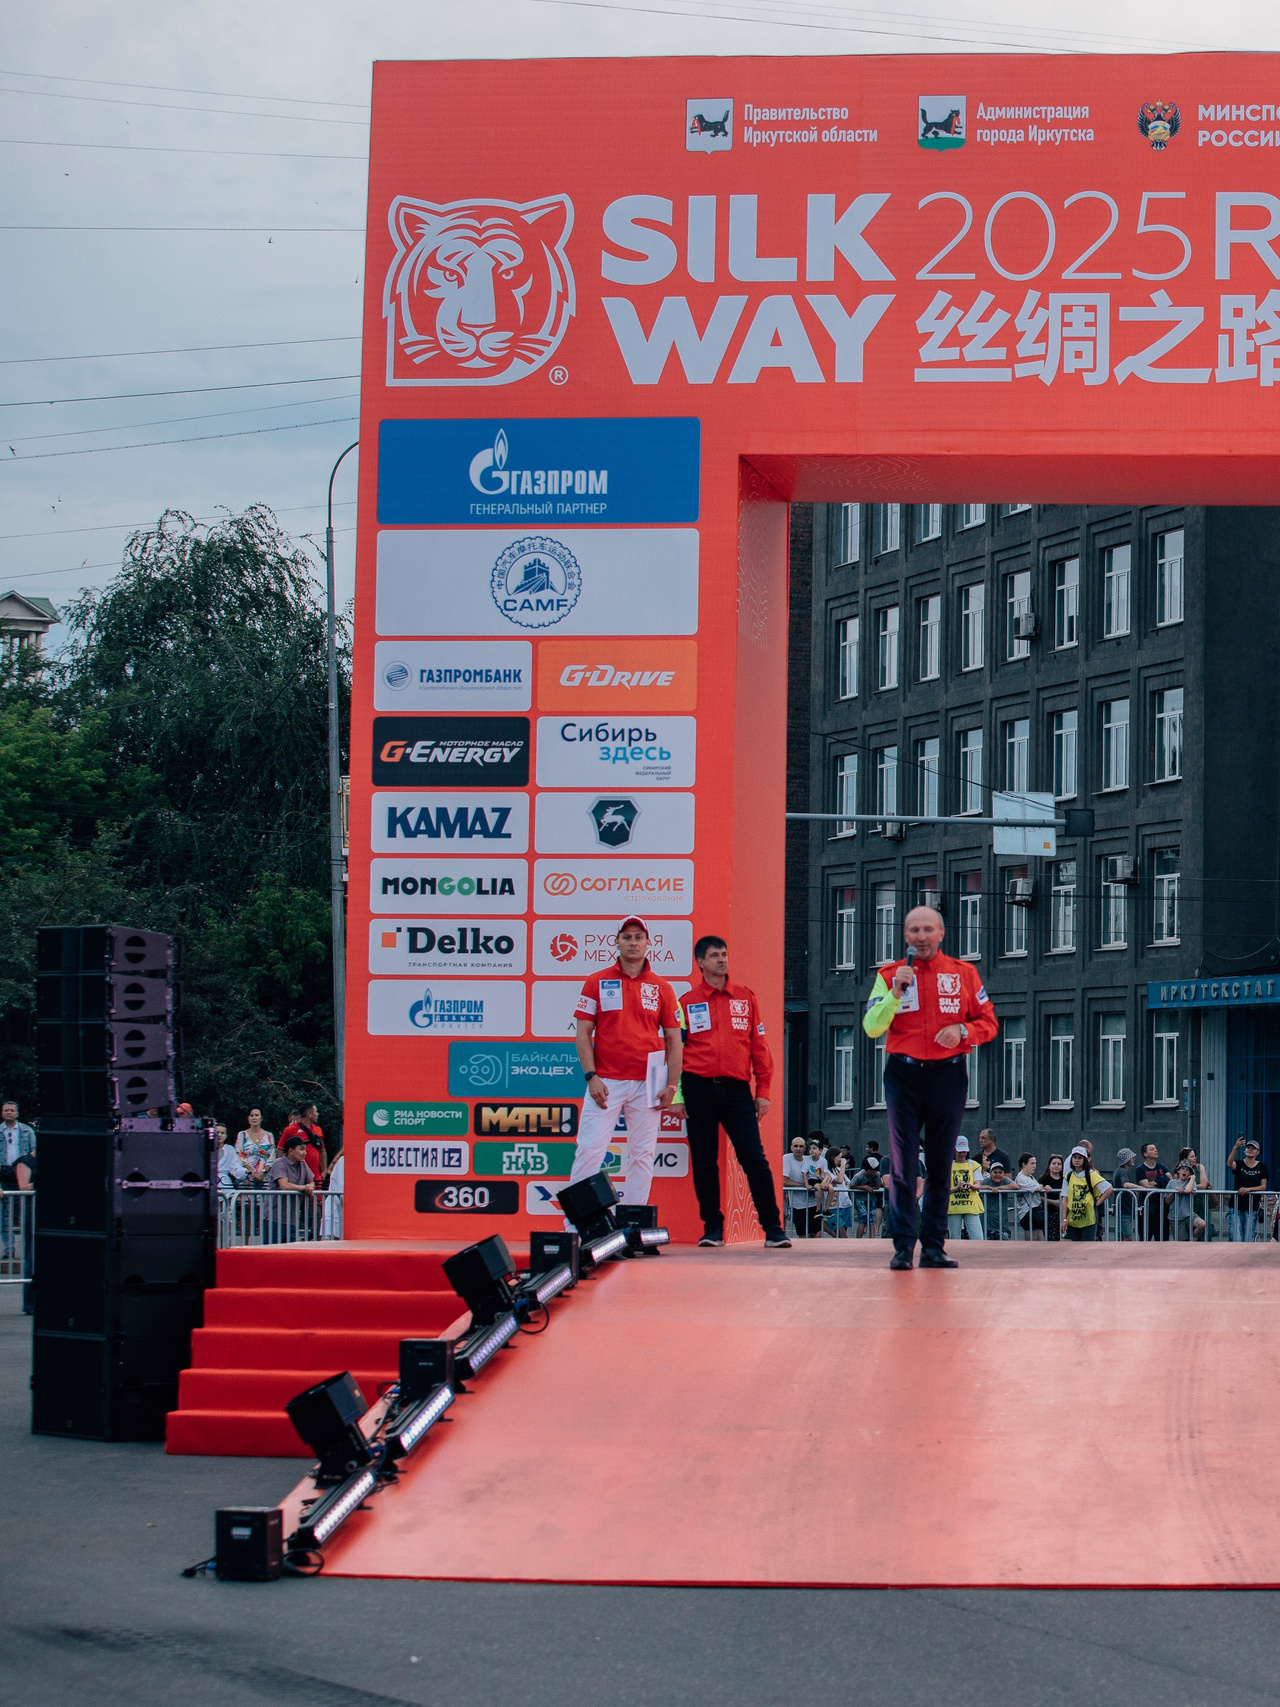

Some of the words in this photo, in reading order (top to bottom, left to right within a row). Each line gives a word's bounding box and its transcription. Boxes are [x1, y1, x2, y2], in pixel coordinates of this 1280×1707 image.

[743, 104, 849, 124] Правительство
[976, 102, 1090, 123] Администрация
[743, 126, 817, 147] Иркутской
[820, 125, 878, 144] области
[976, 127, 1025, 146] города
[1028, 125, 1095, 147] Иркутска
[600, 193, 898, 285] SILK
[915, 190, 1192, 281] 2025
[601, 294, 897, 385] WAY
[510, 469, 608, 495] ГАЗПРОМ
[469, 500, 553, 515] ГЕНЕРАЛЬНЫЙ
[556, 502, 608, 515] ПАРТНЕР
[503, 598, 569, 612] CAMF
[419, 668, 523, 684] ГАЗПРОМБАНК
[560, 722, 658, 747] Сибирь
[438, 740, 490, 748] МОТОРНОЕ
[491, 740, 525, 748] МАСЛО
[599, 746, 672, 765] здесь
[387, 806, 512, 839] KAMAZ
[381, 876, 516, 896] MONGOLIA
[580, 877, 685, 892] СОГЛАСИЕ
[625, 895, 685, 903] страхование
[406, 926, 516, 955] Delko
[584, 934, 664, 947] РУСЯ
[584, 949, 676, 962] МЕХИКА
[1160, 979, 1276, 1002] ИРКУТСКСТАТ
[434, 999, 484, 1014] ГАЗПРОМ
[939, 998, 961, 1006] SILK
[939, 1005, 960, 1014] WAY
[435, 1014, 483, 1022] ДОБЫЧА
[731, 1017, 749, 1025] SILK
[731, 1023, 749, 1031] WAY
[511, 1051, 580, 1063] БАЙКАЛЬ
[510, 1066, 574, 1077] ЭКО.ЦЕХ
[393, 1110, 415, 1118] РИА
[416, 1110, 463, 1119] НОВОСТИ
[393, 1118, 426, 1126] СПОРТ
[481, 1106, 572, 1133] МАТЧ!
[662, 1114, 680, 1127] 24
[371, 1146, 439, 1168] ИЗВЕСТИЯ
[502, 1143, 549, 1175] НТВ
[443, 1186, 490, 1208] 360
